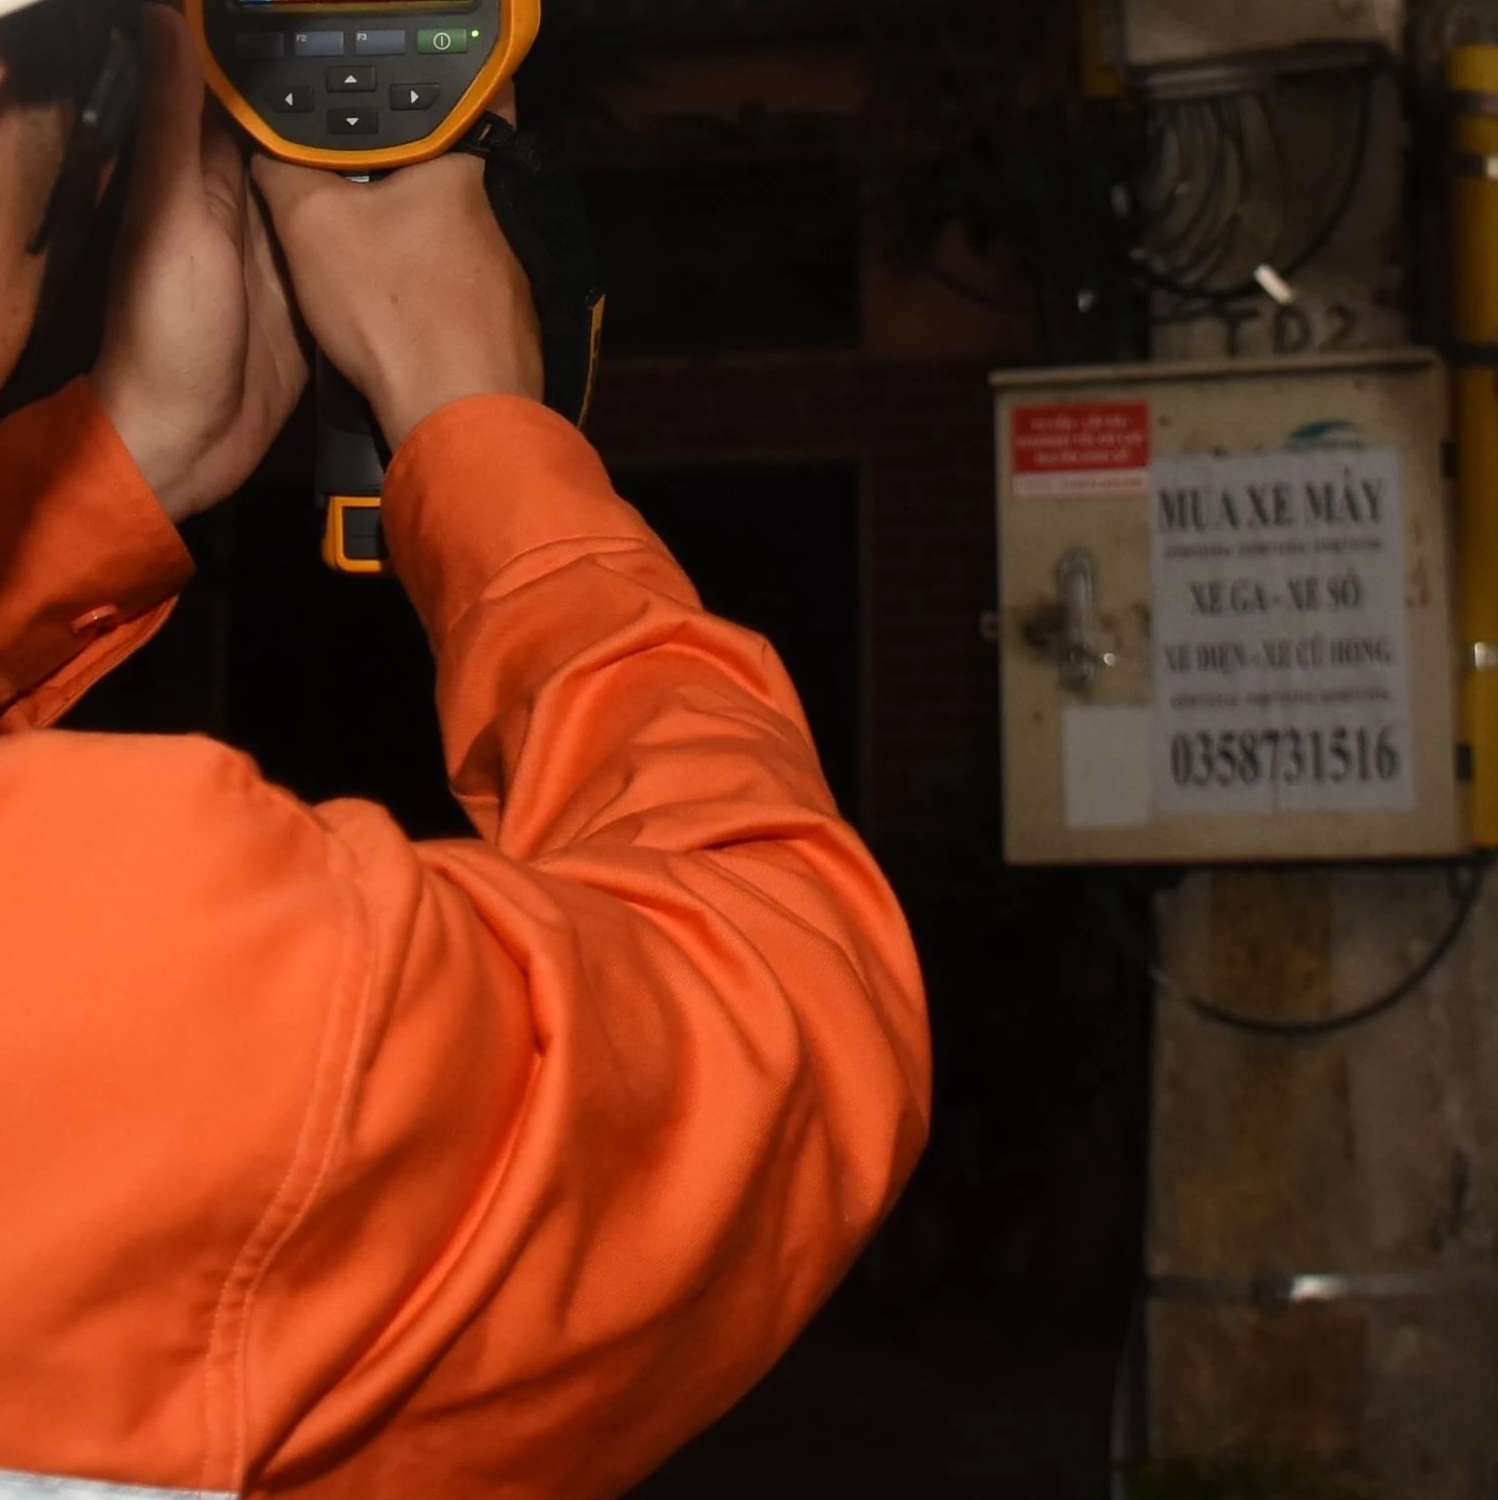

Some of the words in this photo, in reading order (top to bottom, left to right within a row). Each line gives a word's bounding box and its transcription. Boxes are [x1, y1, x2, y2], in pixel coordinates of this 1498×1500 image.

[296, 33, 307, 43] F2
[356, 32, 368, 42] F3
[1157, 487, 1240, 533] MUA
[1245, 480, 1296, 527] XE
[1190, 578, 1223, 615] XE
[1230, 576, 1269, 615] GA
[1287, 575, 1320, 613] XE
[1164, 642, 1191, 673] XE
[1262, 637, 1291, 669] XE
[1169, 724, 1401, 788] 0358731516
